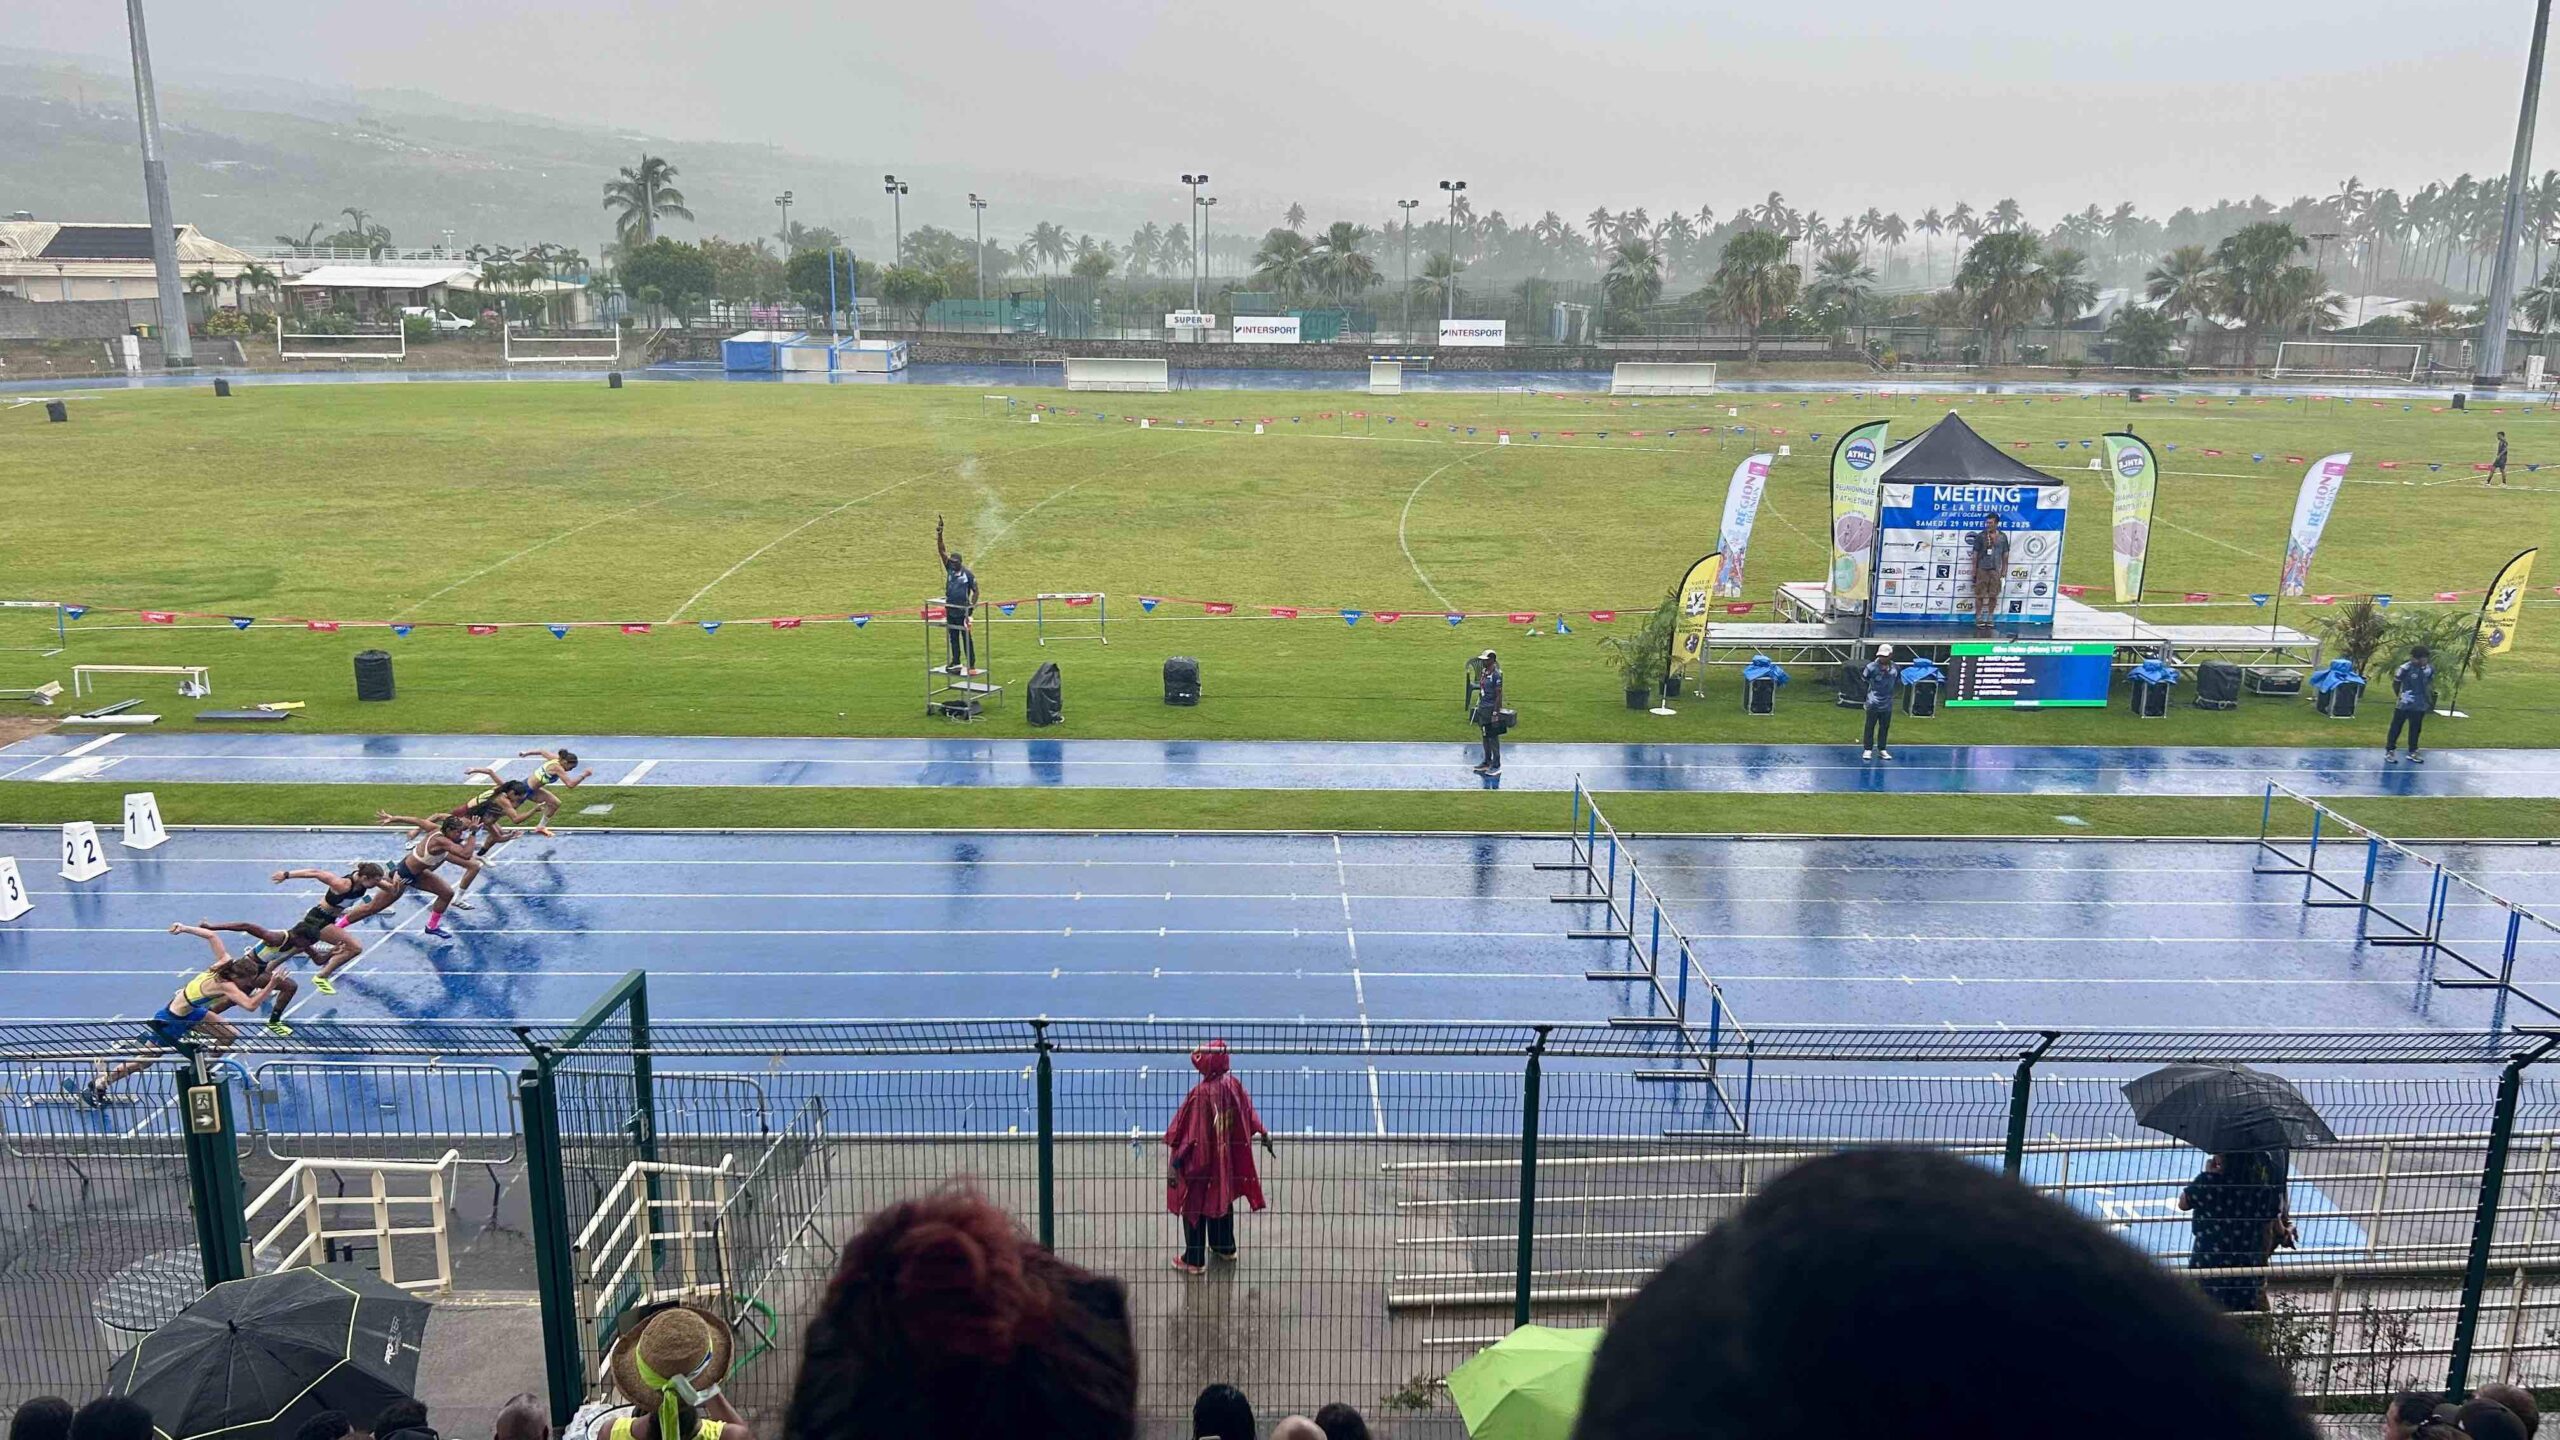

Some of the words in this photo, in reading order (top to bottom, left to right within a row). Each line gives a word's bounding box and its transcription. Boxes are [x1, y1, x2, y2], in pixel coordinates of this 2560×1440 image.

[1174, 316, 1202, 324] SUPER
[1243, 326, 1297, 334] INTERSPORT
[1448, 329, 1503, 337] INTERSPORT
[1846, 450, 1875, 461] ATHLE
[1735, 476, 1757, 526] RÉGION
[1933, 486, 2021, 503] MEETING
[2307, 476, 2333, 526] RÉGION
[1934, 503, 1947, 511] DE
[1952, 503, 1964, 511] LA
[1970, 502, 2019, 512] RÉUNION
[129, 811, 136, 834] 1
[147, 809, 156, 832] 1
[66, 841, 74, 866] 2
[84, 839, 97, 864] 2
[7, 876, 18, 901] 3
